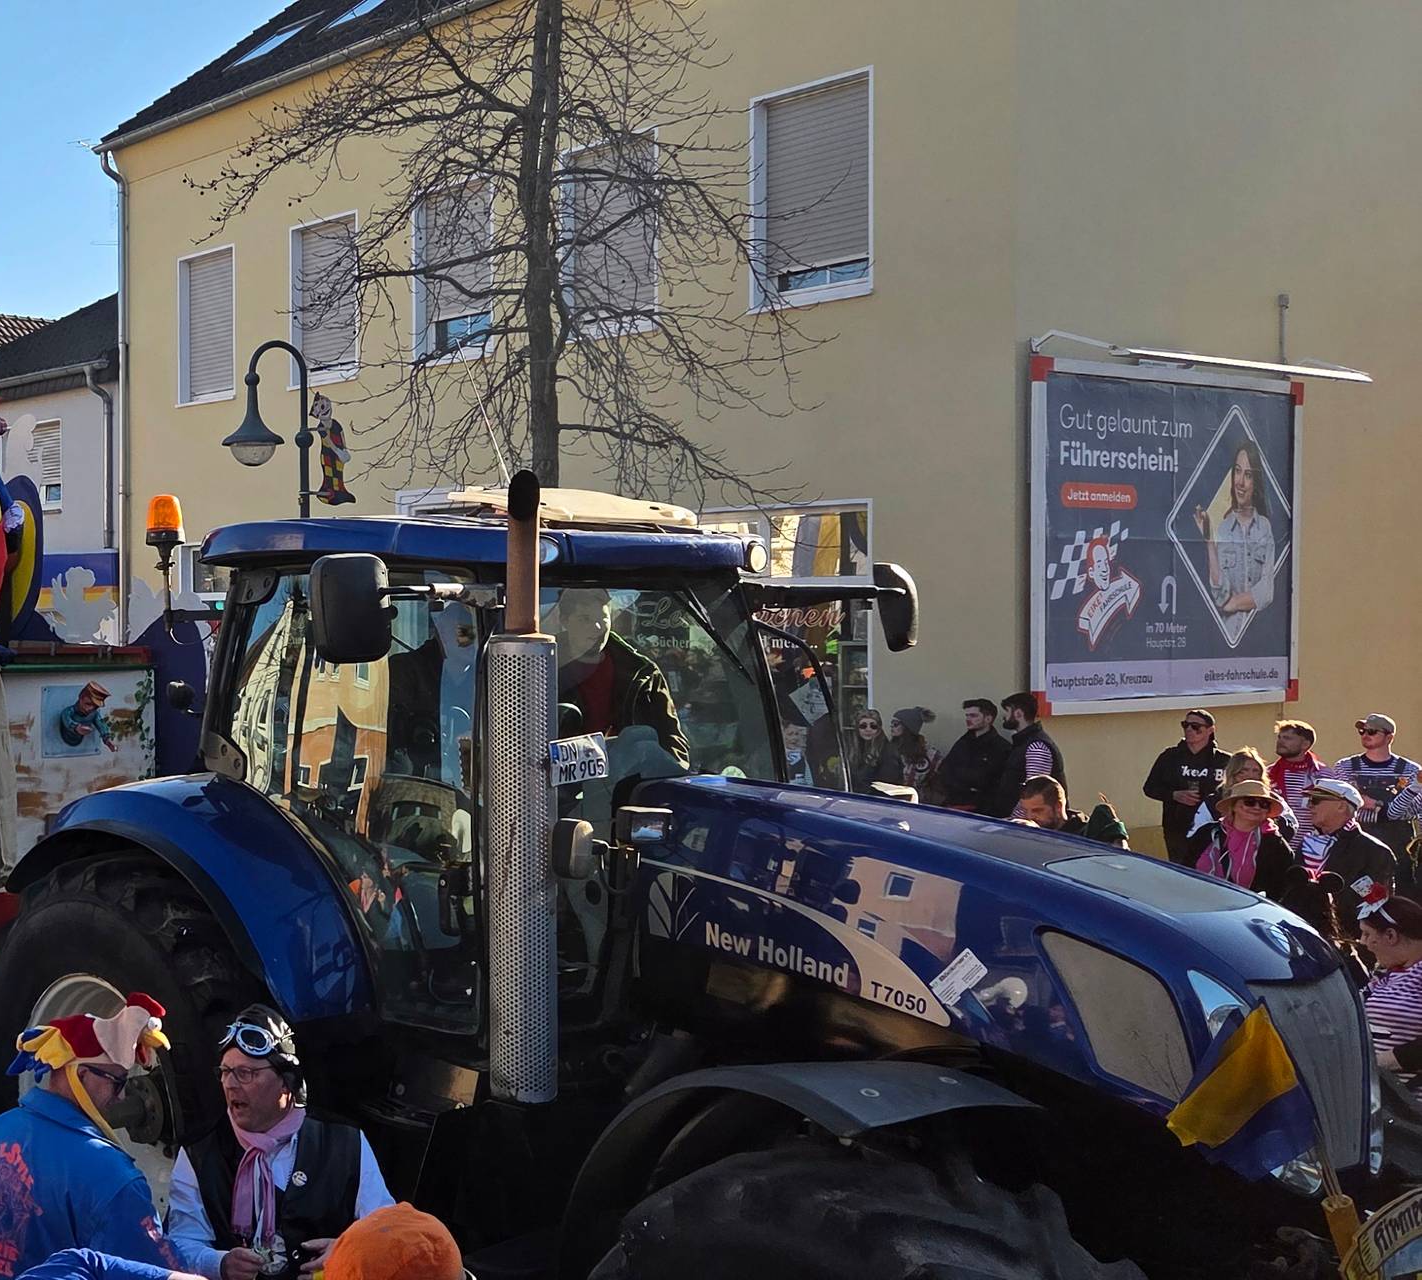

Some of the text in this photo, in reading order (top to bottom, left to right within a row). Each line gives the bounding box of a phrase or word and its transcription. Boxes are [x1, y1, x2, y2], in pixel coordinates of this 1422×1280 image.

[1059, 403, 1193, 440] Gut gelaunt zum
[1059, 440, 1179, 473] Führerschein!
[1067, 489, 1132, 503] Jetzt anmelden
[1154, 622, 1165, 633] 70
[1051, 674, 1104, 690] Hauptstraße
[1119, 672, 1153, 685] Kreuzau
[1204, 668, 1279, 682] eikes-fahrschule.de
[559, 742, 578, 762] DN
[559, 758, 605, 783] MR 905
[705, 921, 849, 989] New Holland
[870, 980, 927, 1015] T7050
